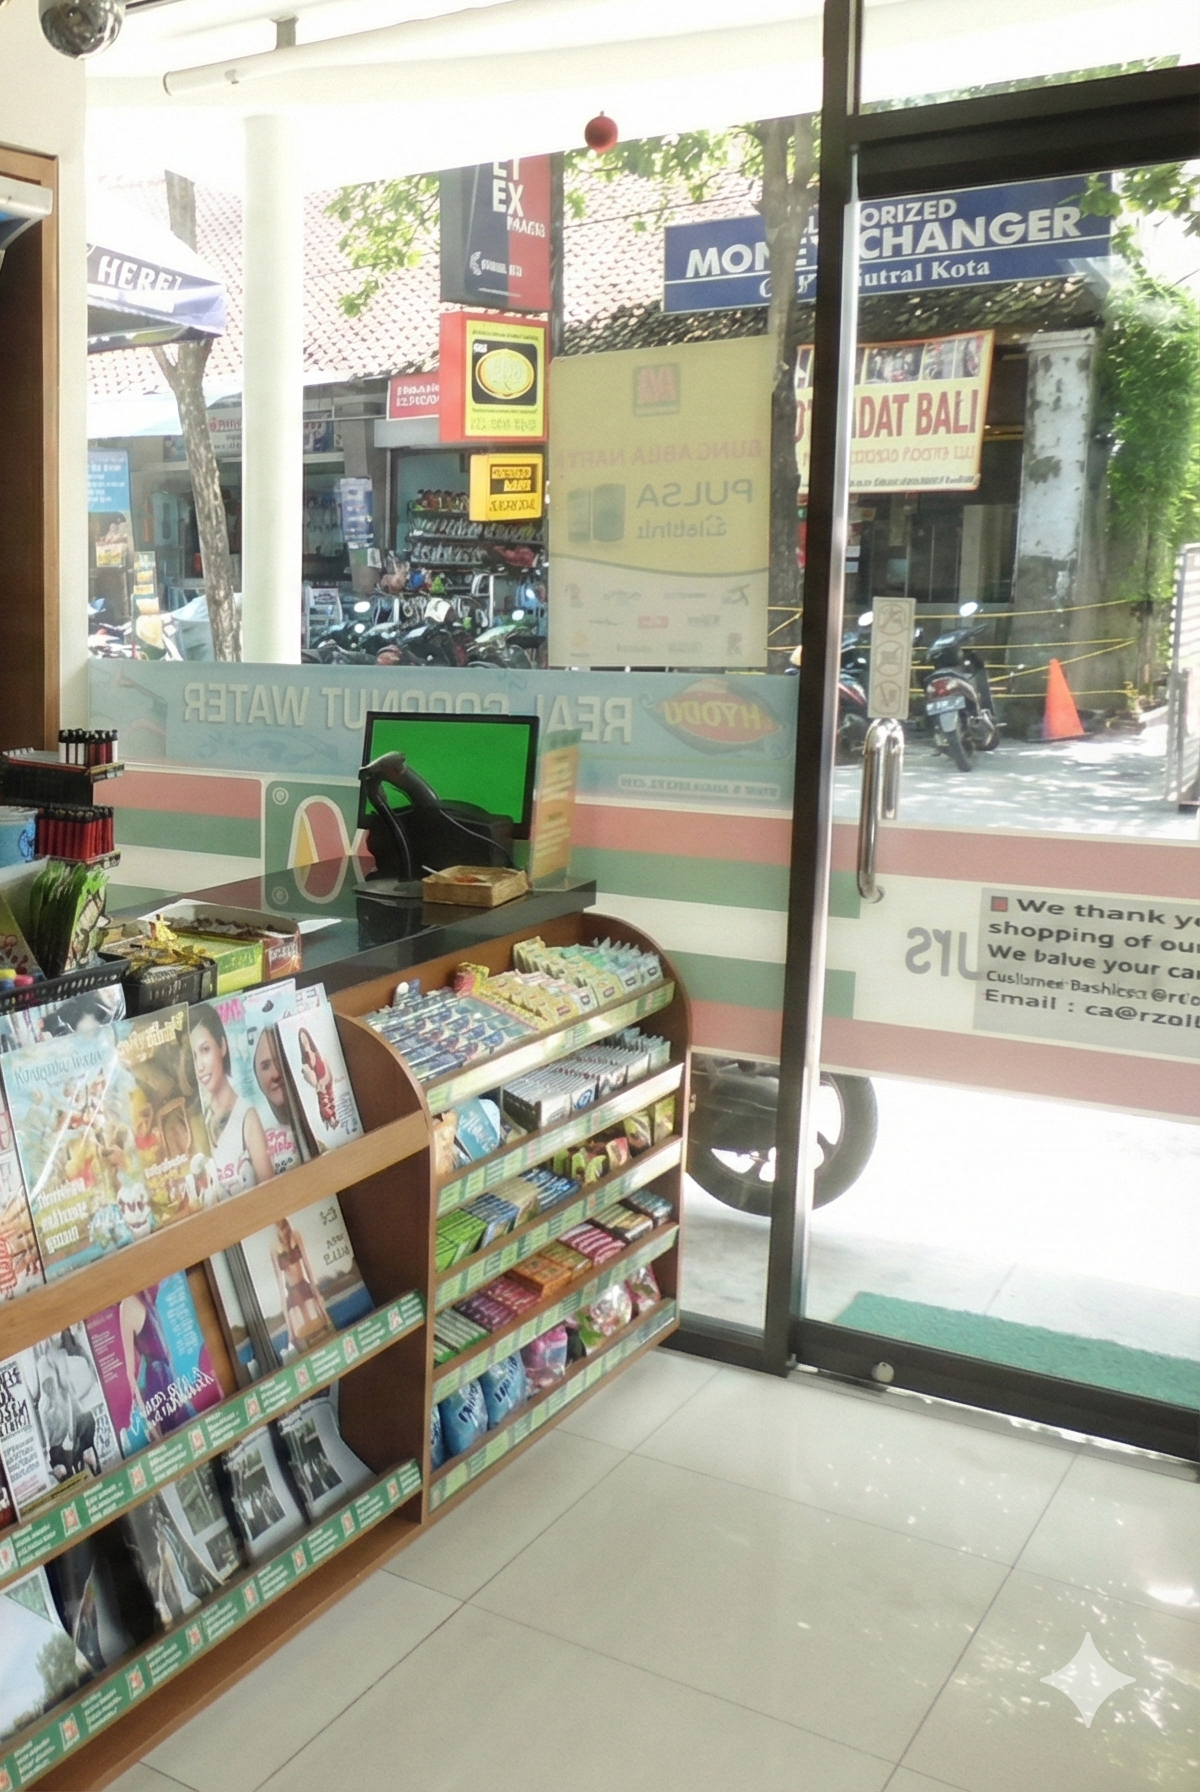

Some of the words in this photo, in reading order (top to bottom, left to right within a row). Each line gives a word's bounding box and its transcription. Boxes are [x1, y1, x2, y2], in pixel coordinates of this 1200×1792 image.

[685, 234, 819, 278] MONE
[858, 206, 1082, 259] CHANGER
[931, 261, 990, 280] Kota
[915, 389, 979, 436] BALI
[1016, 898, 1065, 916] We
[1073, 903, 1166, 925] thank
[988, 921, 1114, 949] shopping
[1124, 934, 1154, 949] of
[987, 943, 1026, 961] We
[1102, 959, 1161, 975] your
[1167, 966, 1200, 980] ca
[985, 988, 1057, 1010] Email
